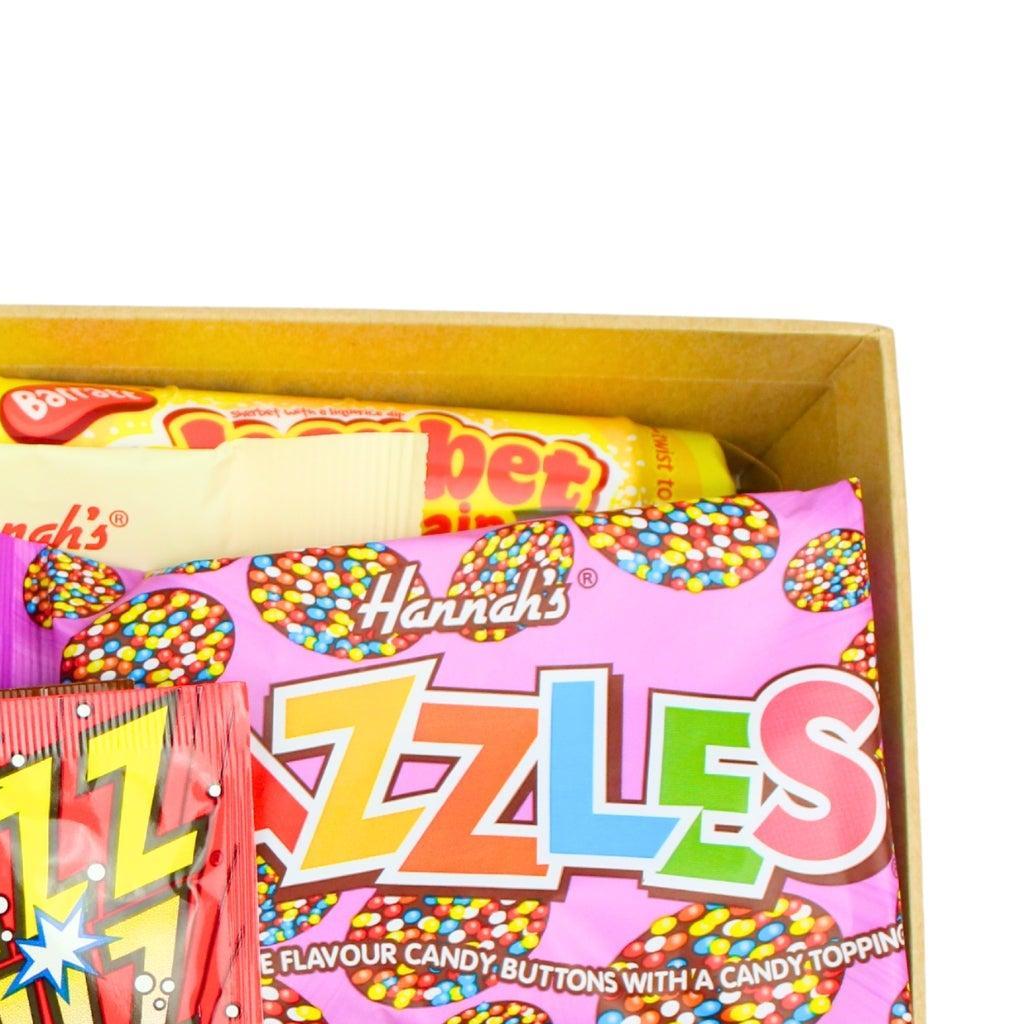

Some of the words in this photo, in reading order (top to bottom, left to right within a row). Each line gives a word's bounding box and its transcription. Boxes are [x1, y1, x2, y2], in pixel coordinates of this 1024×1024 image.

[12, 384, 144, 421] Barratt
[357, 563, 568, 635] Hannah's
[252, 658, 888, 900] ZZLES
[281, 942, 398, 973] FLAVOUR
[404, 944, 497, 975] CANDY
[501, 957, 619, 994] BUTTONS
[622, 969, 688, 994] WITH
[694, 969, 714, 991] A
[720, 955, 805, 989] CANDY
